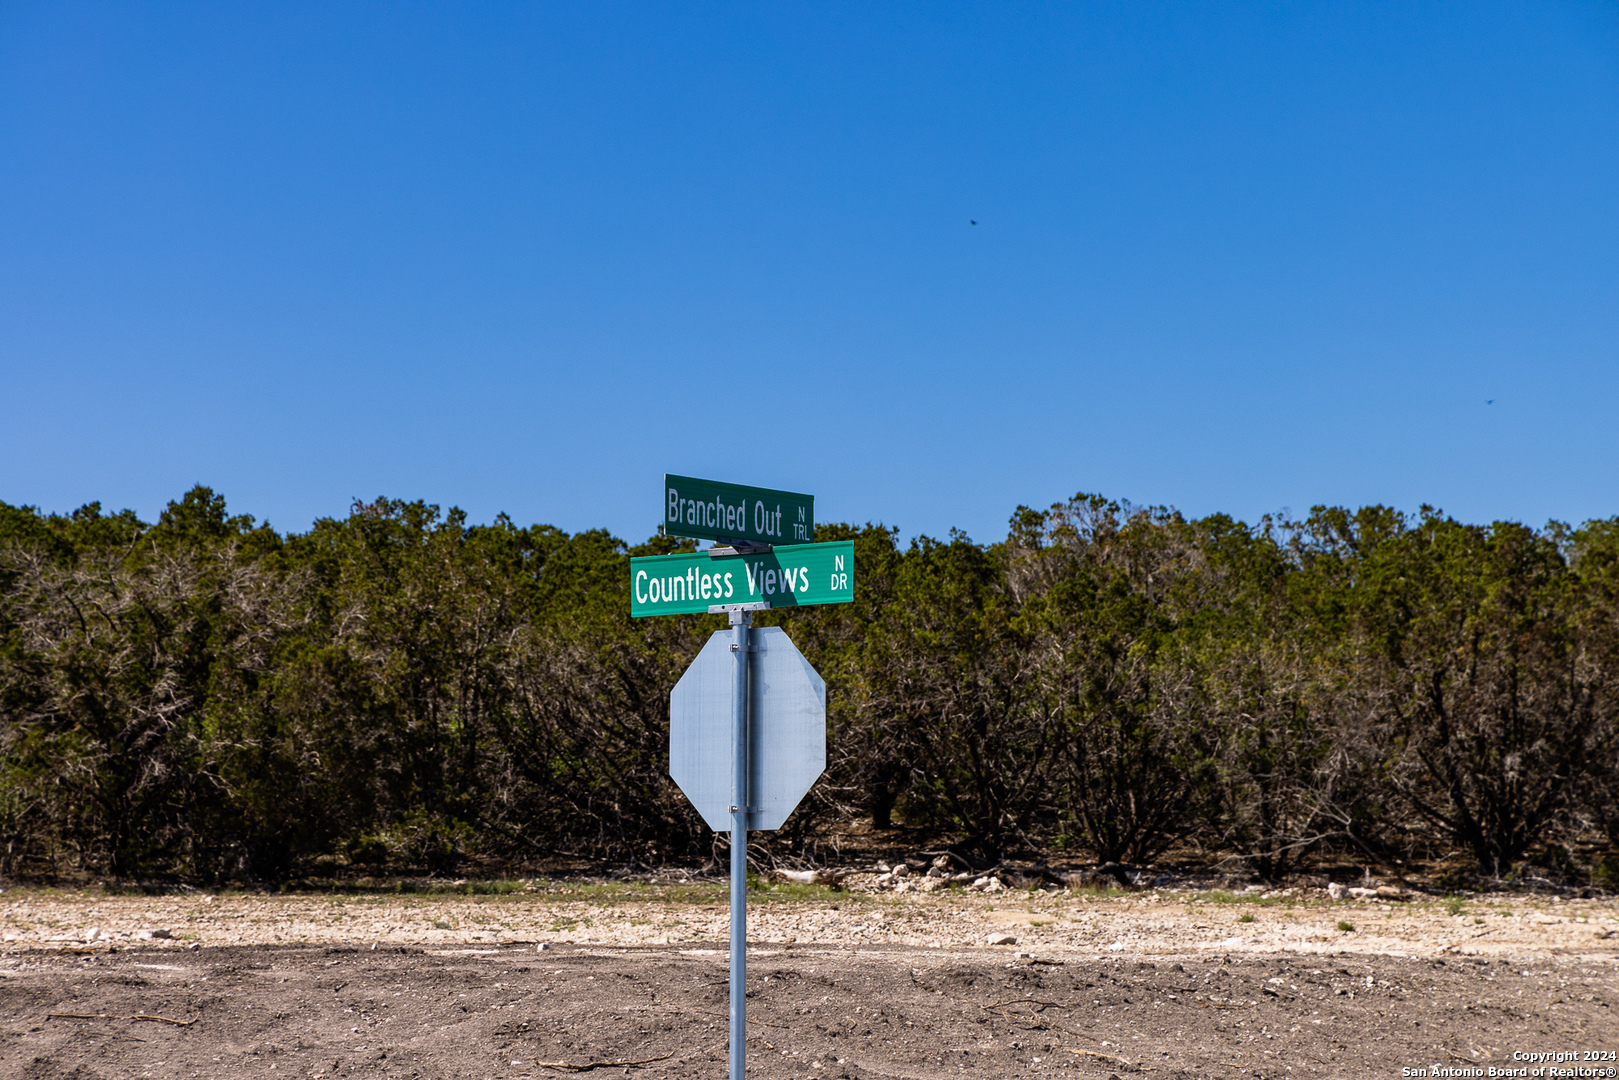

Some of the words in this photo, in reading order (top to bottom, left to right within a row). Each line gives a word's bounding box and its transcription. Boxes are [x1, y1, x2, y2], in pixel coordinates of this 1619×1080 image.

[668, 488, 746, 532] Branched
[754, 500, 782, 537] Out
[798, 506, 805, 522] N
[793, 524, 810, 541] TRL
[835, 555, 844, 571] N
[635, 566, 734, 603] Countless
[745, 561, 809, 596] Views
[831, 573, 848, 591] DR
